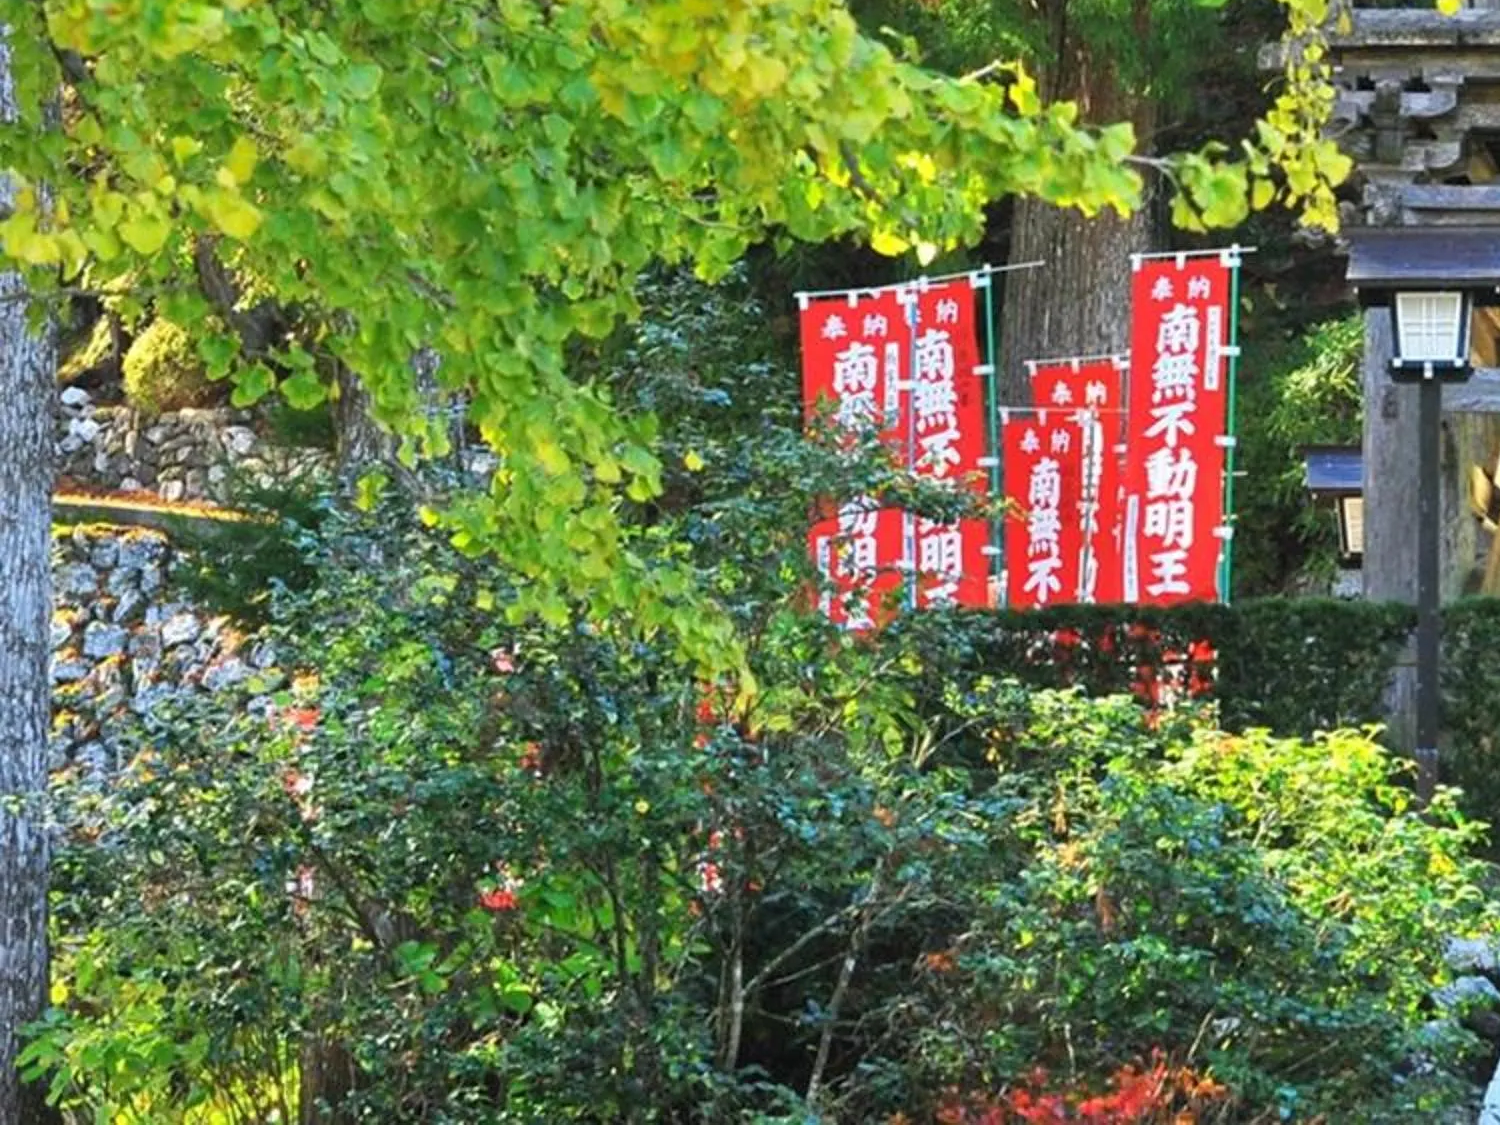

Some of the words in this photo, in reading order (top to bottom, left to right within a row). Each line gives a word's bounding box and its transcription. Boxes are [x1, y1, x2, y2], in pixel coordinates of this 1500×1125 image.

[1023, 456, 1063, 609] 南無不
[1143, 302, 1201, 596] 南無不動明王
